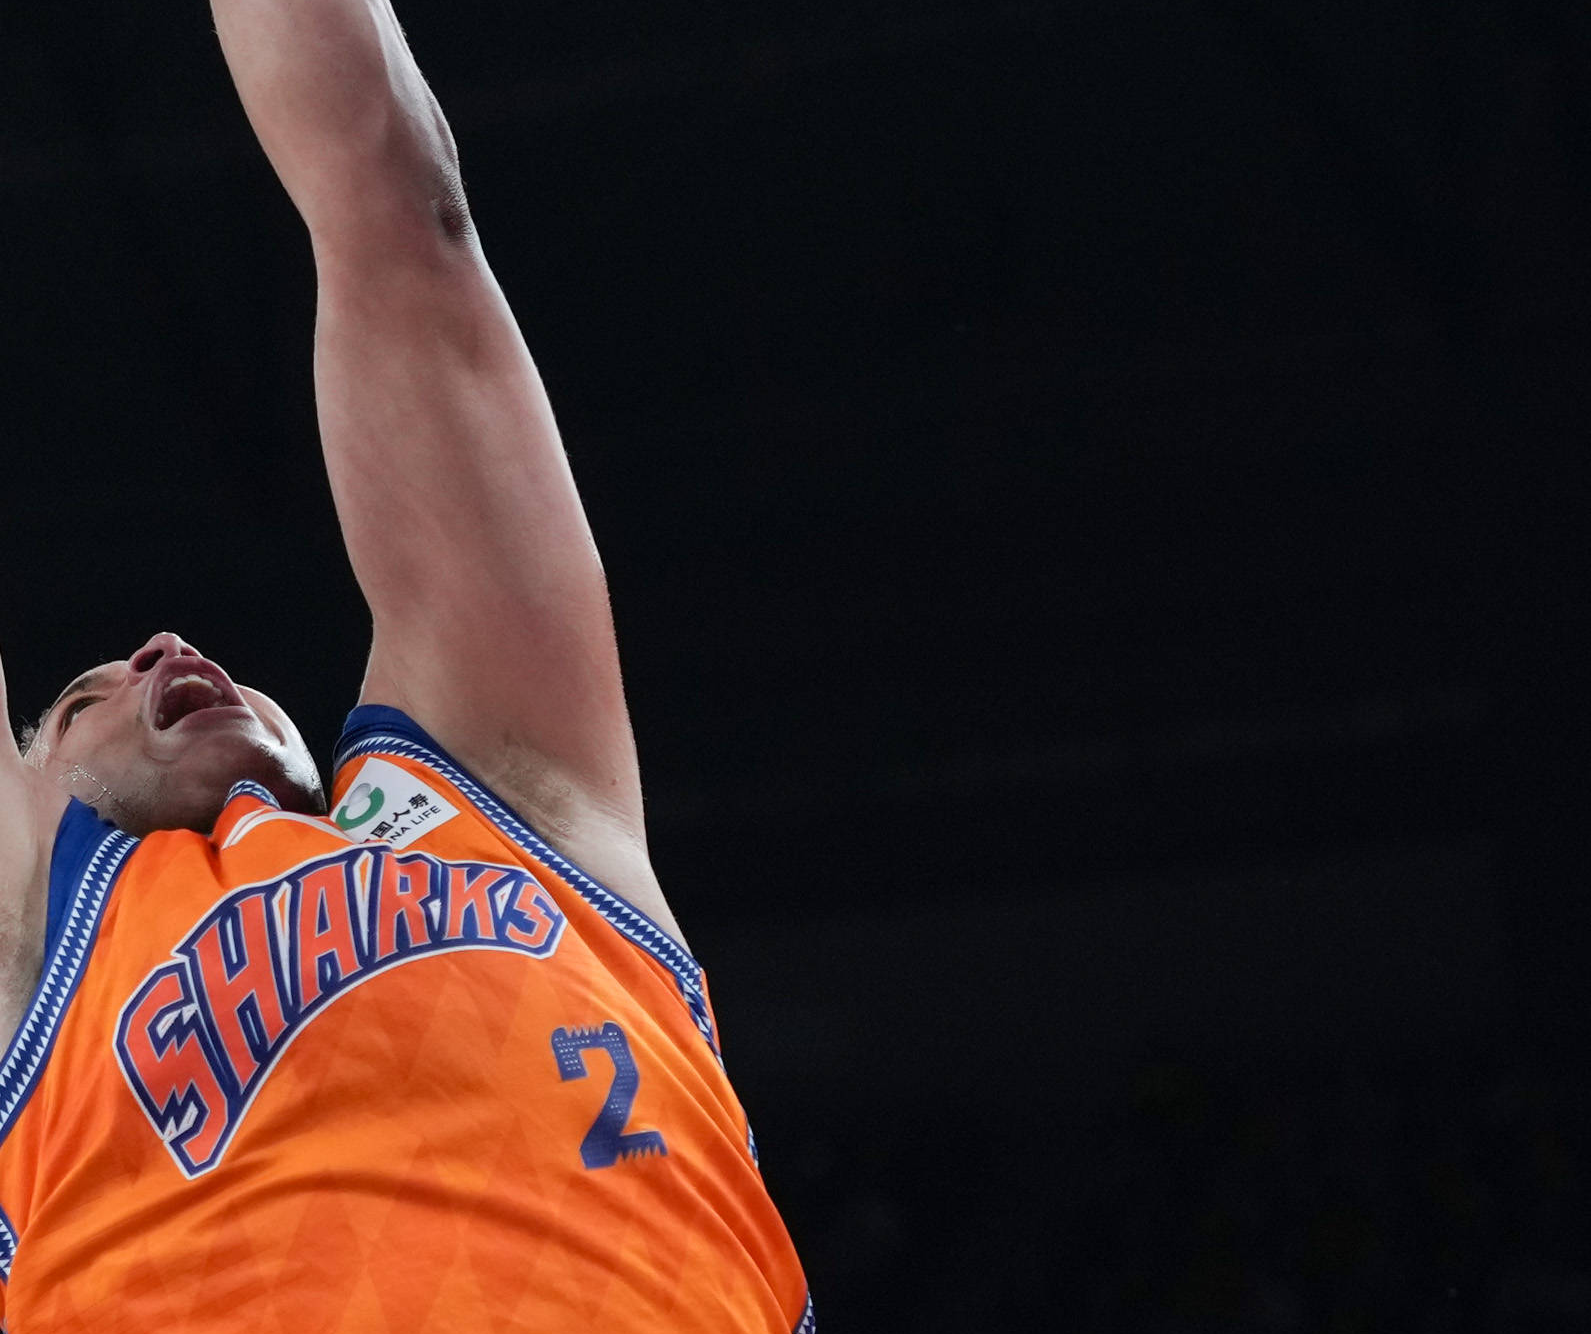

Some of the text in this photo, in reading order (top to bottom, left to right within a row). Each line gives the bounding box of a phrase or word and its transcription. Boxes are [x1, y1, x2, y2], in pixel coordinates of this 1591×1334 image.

[360, 792, 429, 843] 国人寿
[410, 805, 442, 826] LIFE
[112, 839, 568, 1181] SHARKS
[550, 1021, 668, 1169] 2
